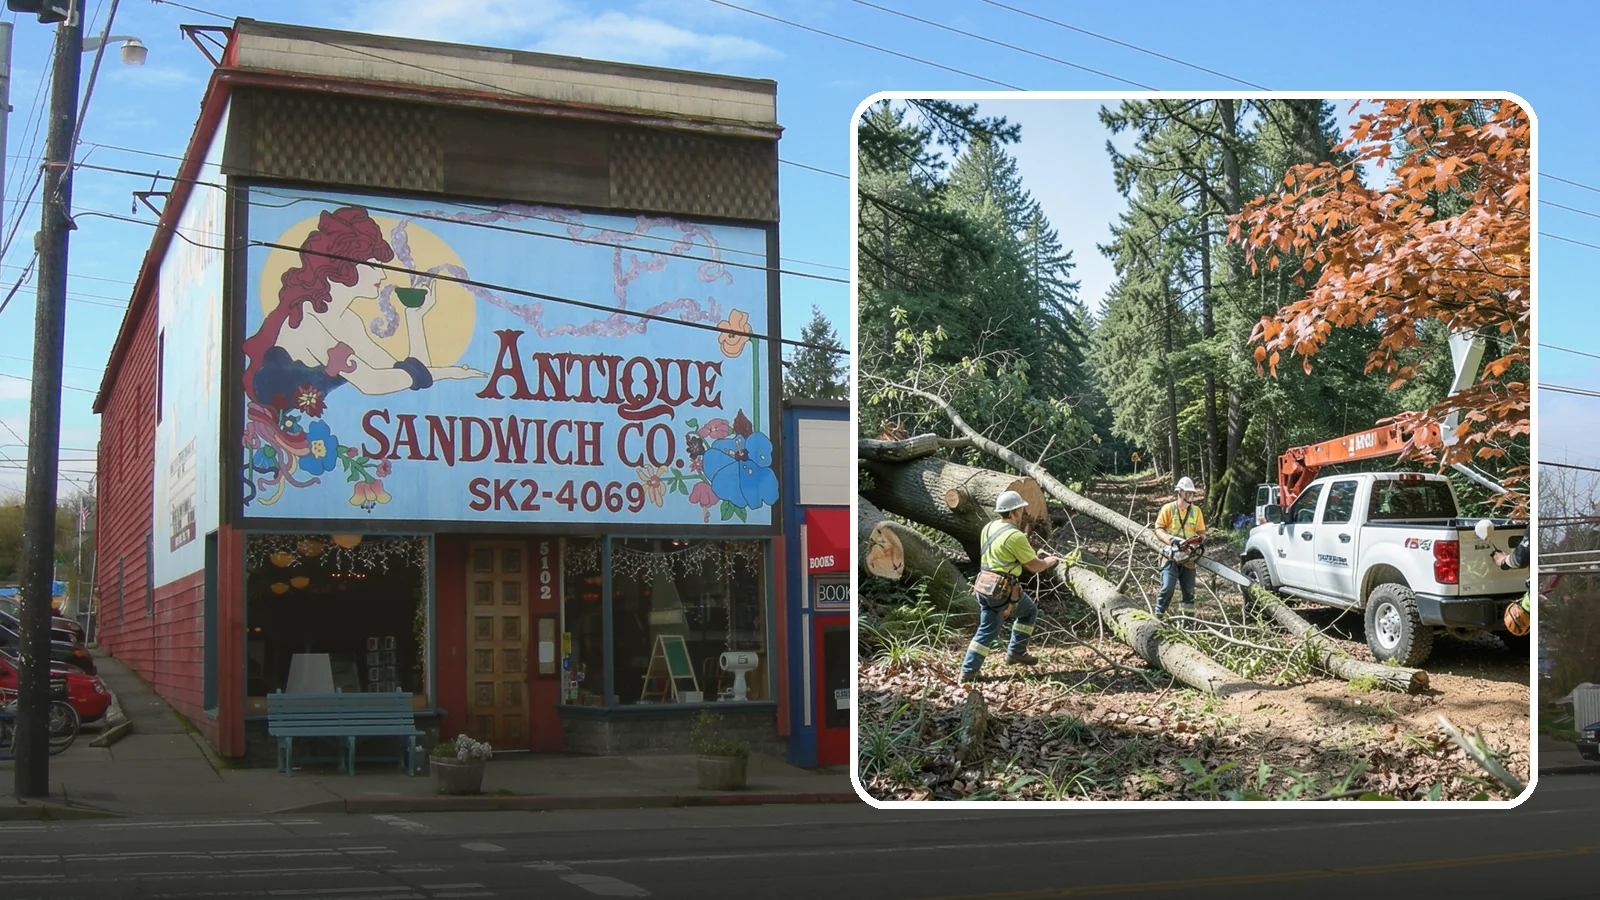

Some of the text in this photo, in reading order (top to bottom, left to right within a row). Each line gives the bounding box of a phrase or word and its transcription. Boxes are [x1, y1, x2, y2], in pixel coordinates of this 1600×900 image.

[361, 408, 686, 468] SANDWICH CO.
[468, 477, 646, 512] SK2-4069
[539, 542, 552, 600] 5102
[809, 555, 835, 569] BOOKS
